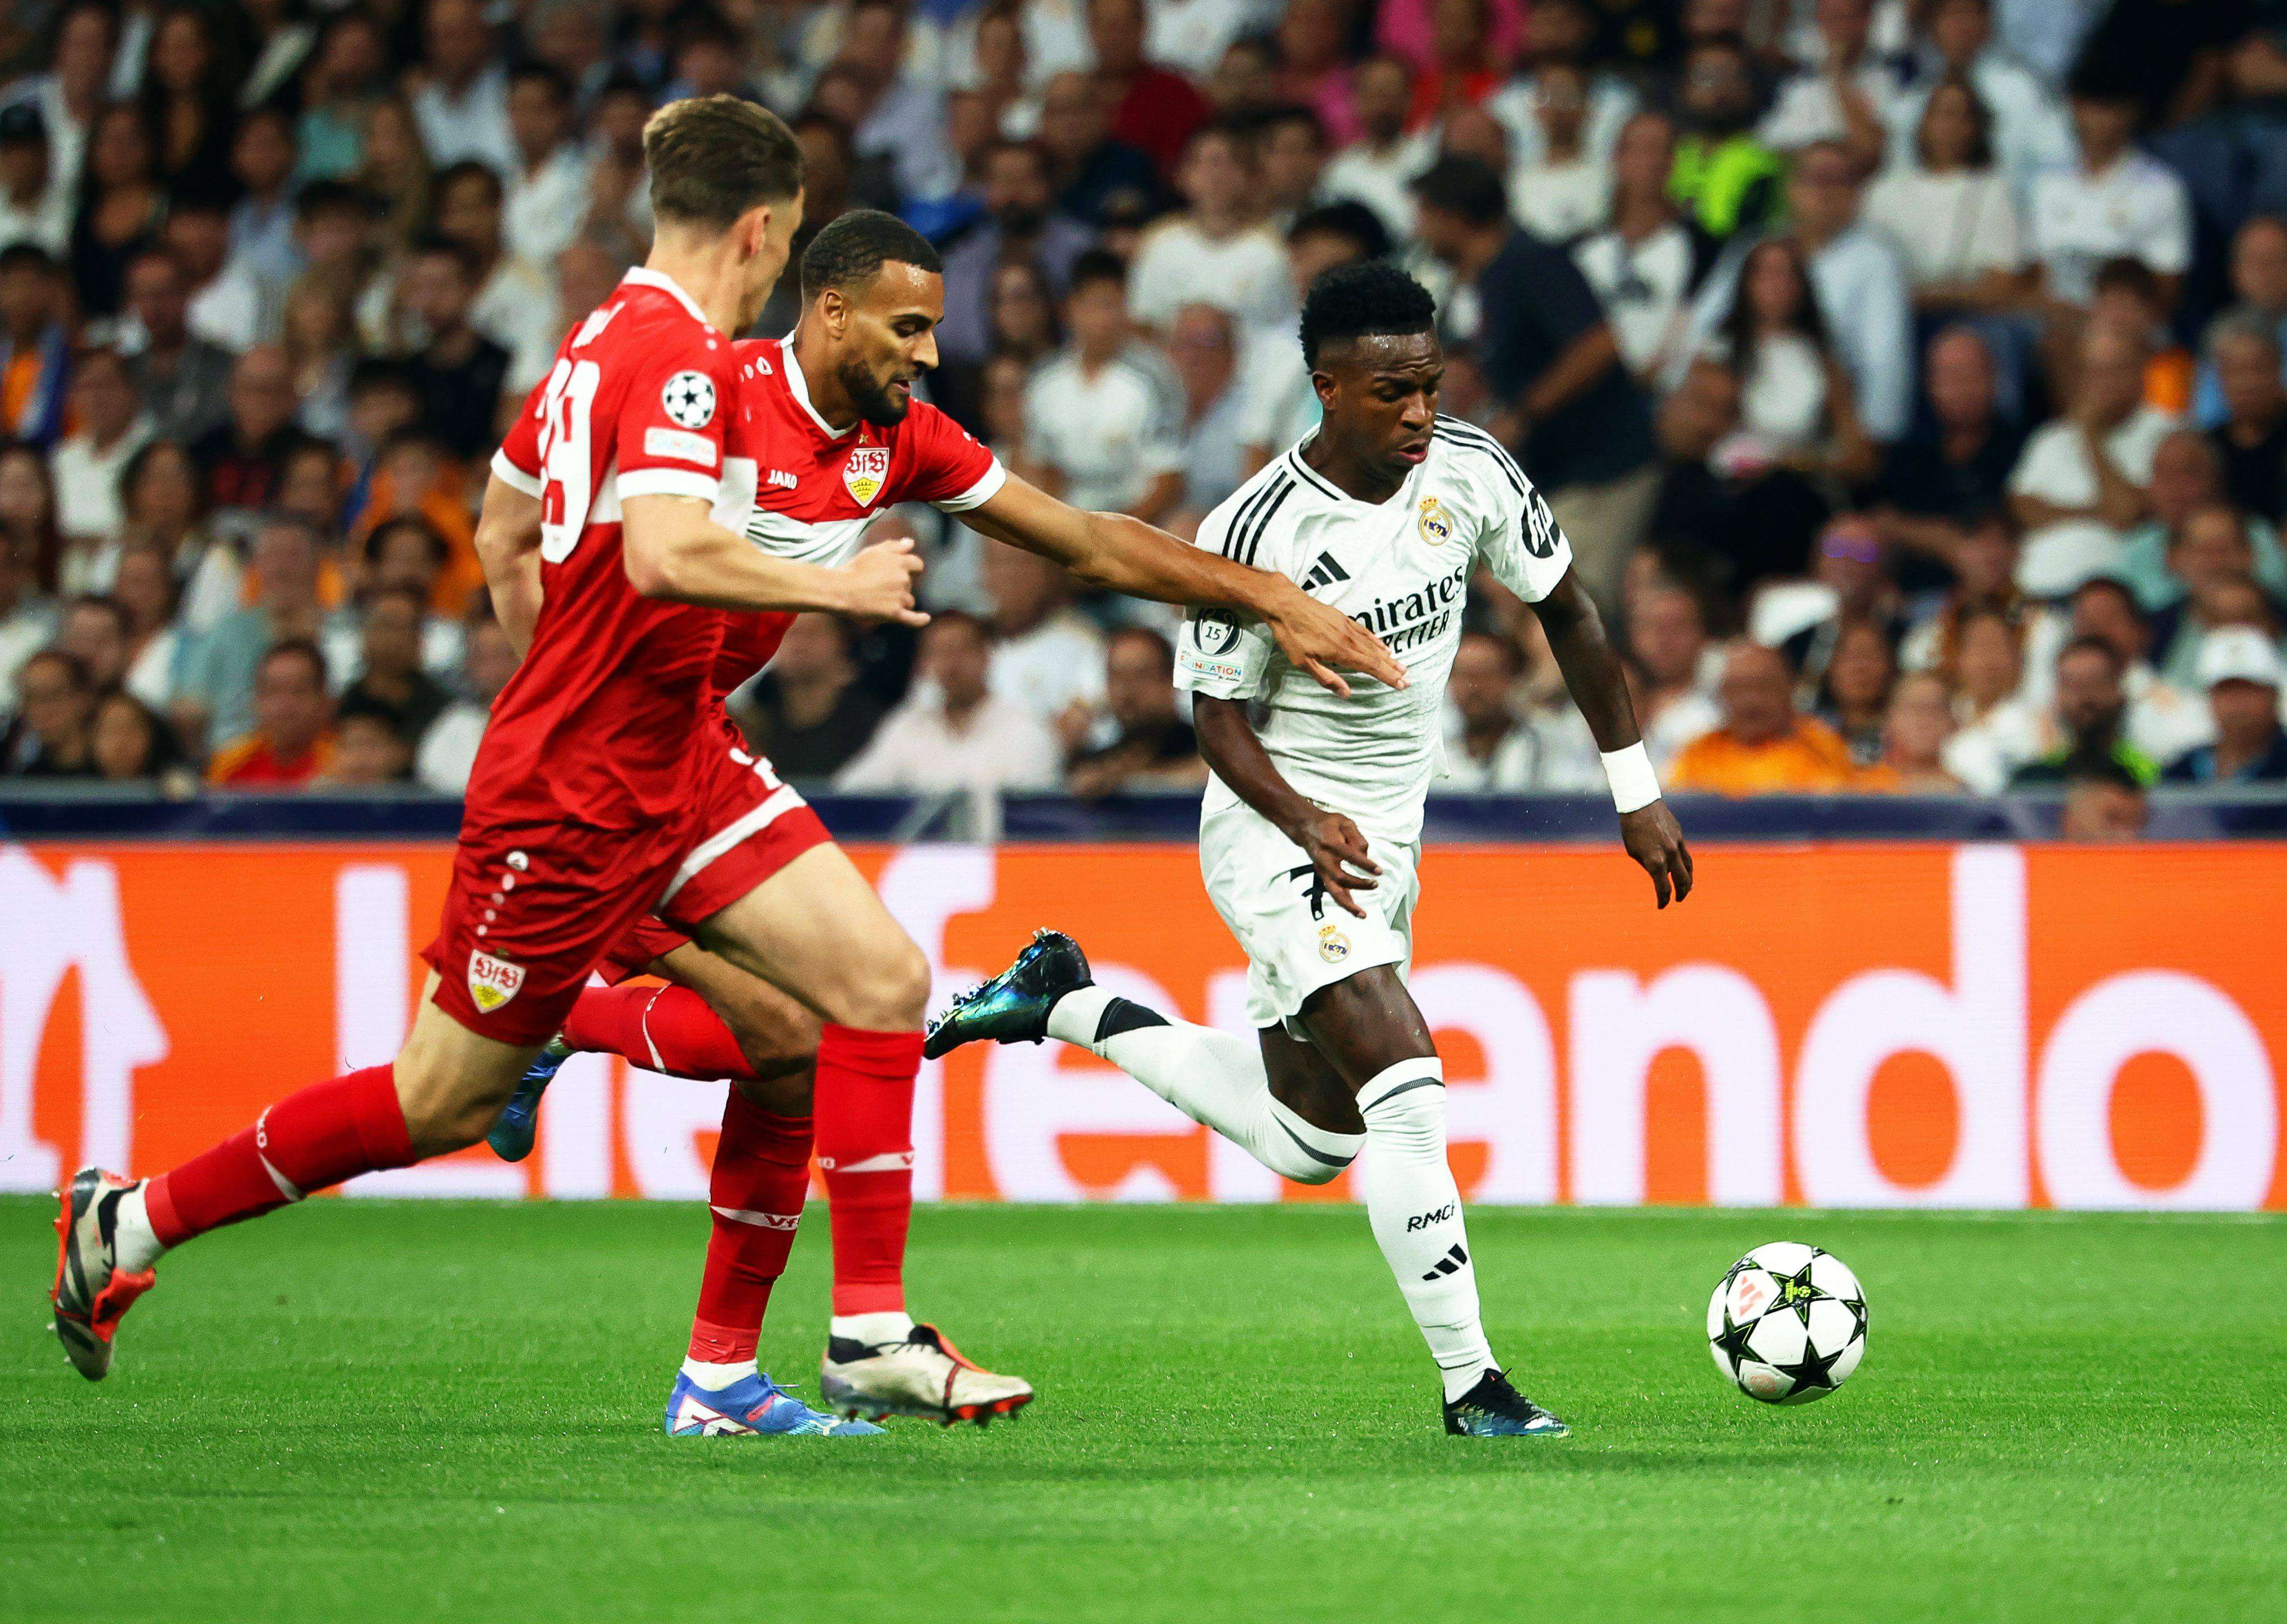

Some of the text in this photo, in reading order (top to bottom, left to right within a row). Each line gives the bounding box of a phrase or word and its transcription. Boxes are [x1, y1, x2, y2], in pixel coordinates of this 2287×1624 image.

[767, 469, 798, 490] JAKO
[1522, 488, 1558, 556] hp
[1348, 565, 1462, 634] mirates
[1205, 626, 1221, 640] 15
[764, 1214, 799, 1228] Vf
